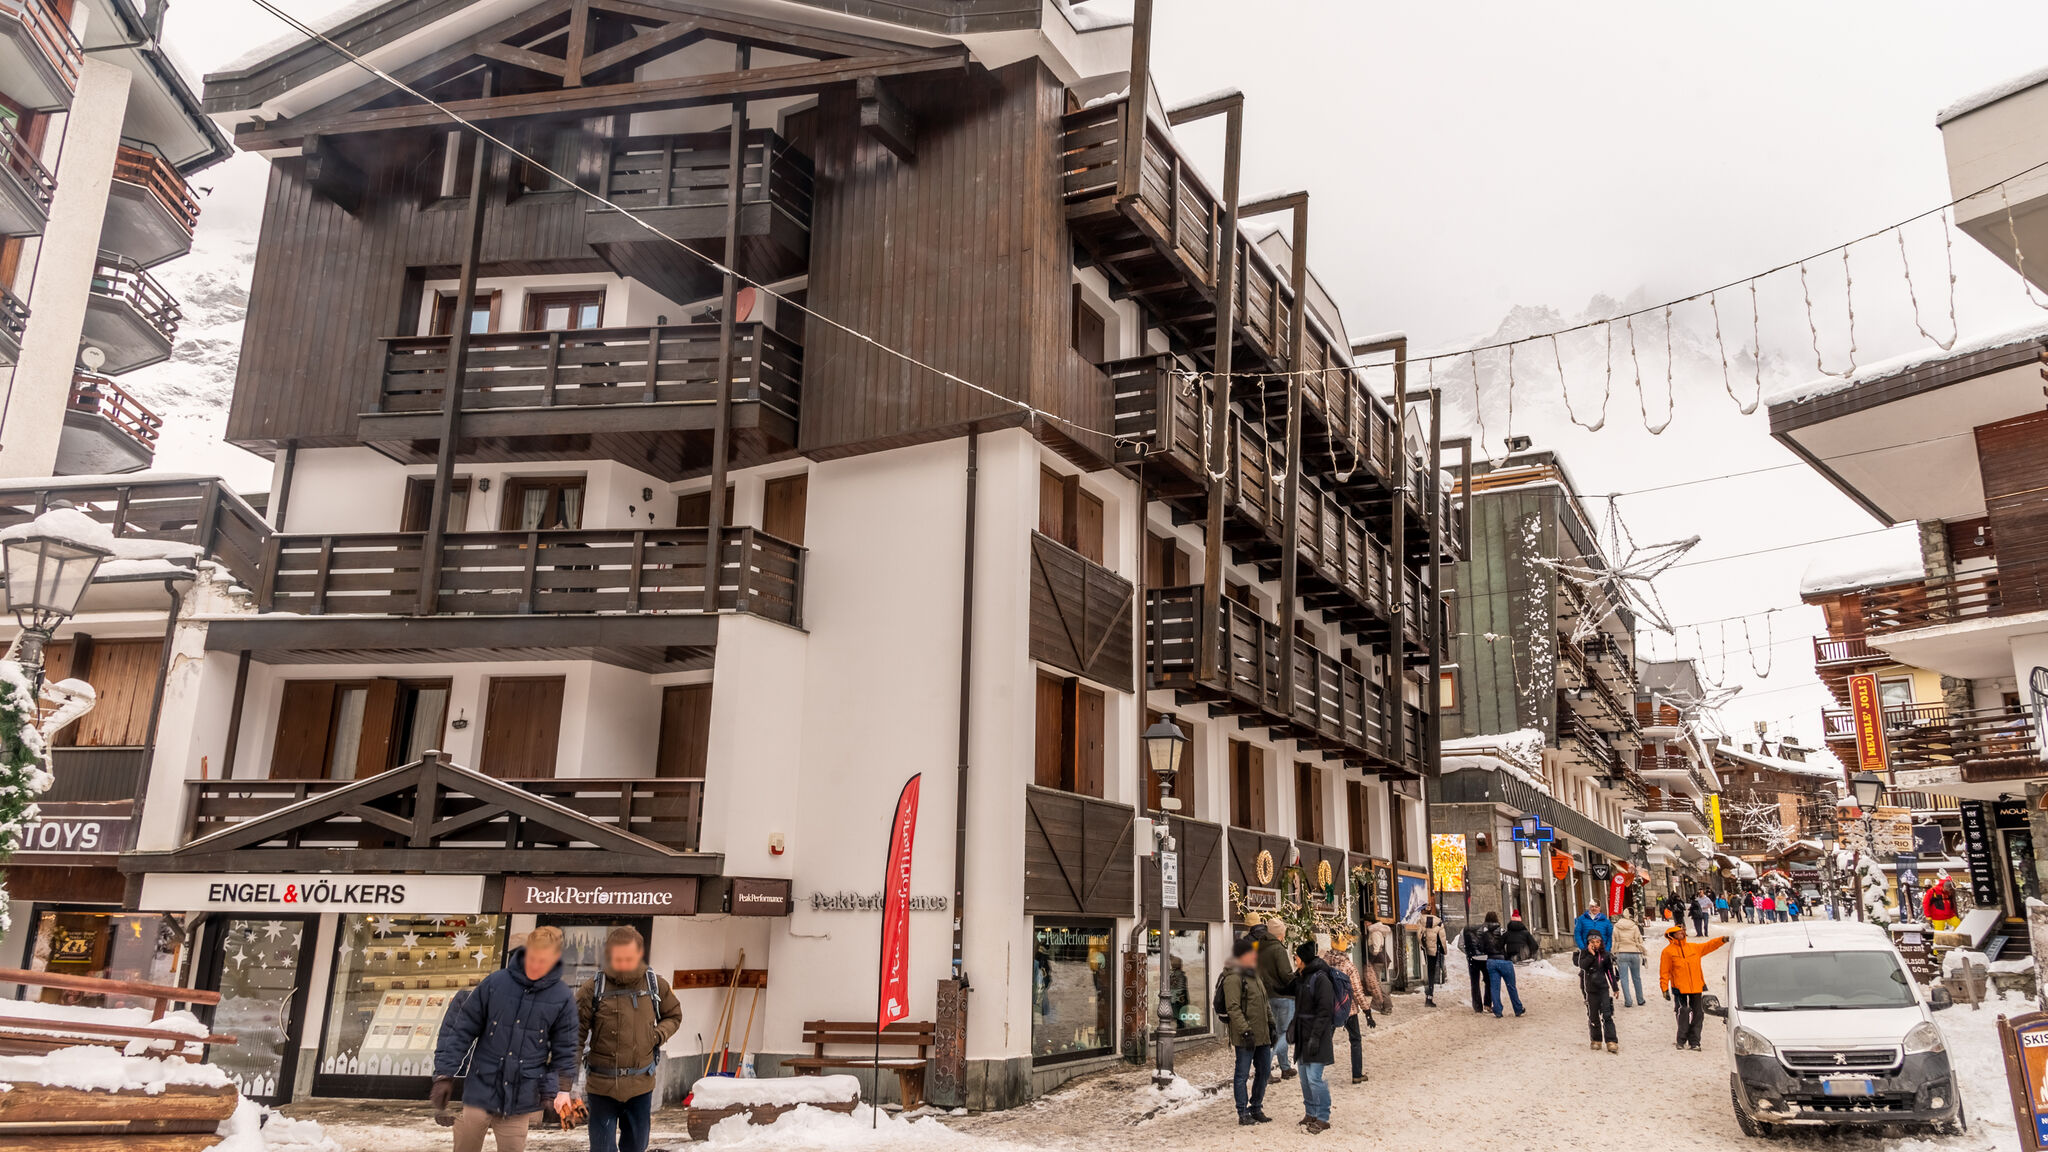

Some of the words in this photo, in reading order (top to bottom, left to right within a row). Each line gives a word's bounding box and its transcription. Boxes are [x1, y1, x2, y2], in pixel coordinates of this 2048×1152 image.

[1859, 685, 1870, 709] JOLI
[1862, 712, 1876, 756] MEUBLE'
[23, 822, 101, 849] TOYS
[525, 886, 672, 906] PeakPerformance
[812, 890, 948, 911] PeakPerfance
[1898, 944, 1925, 952] taurant
